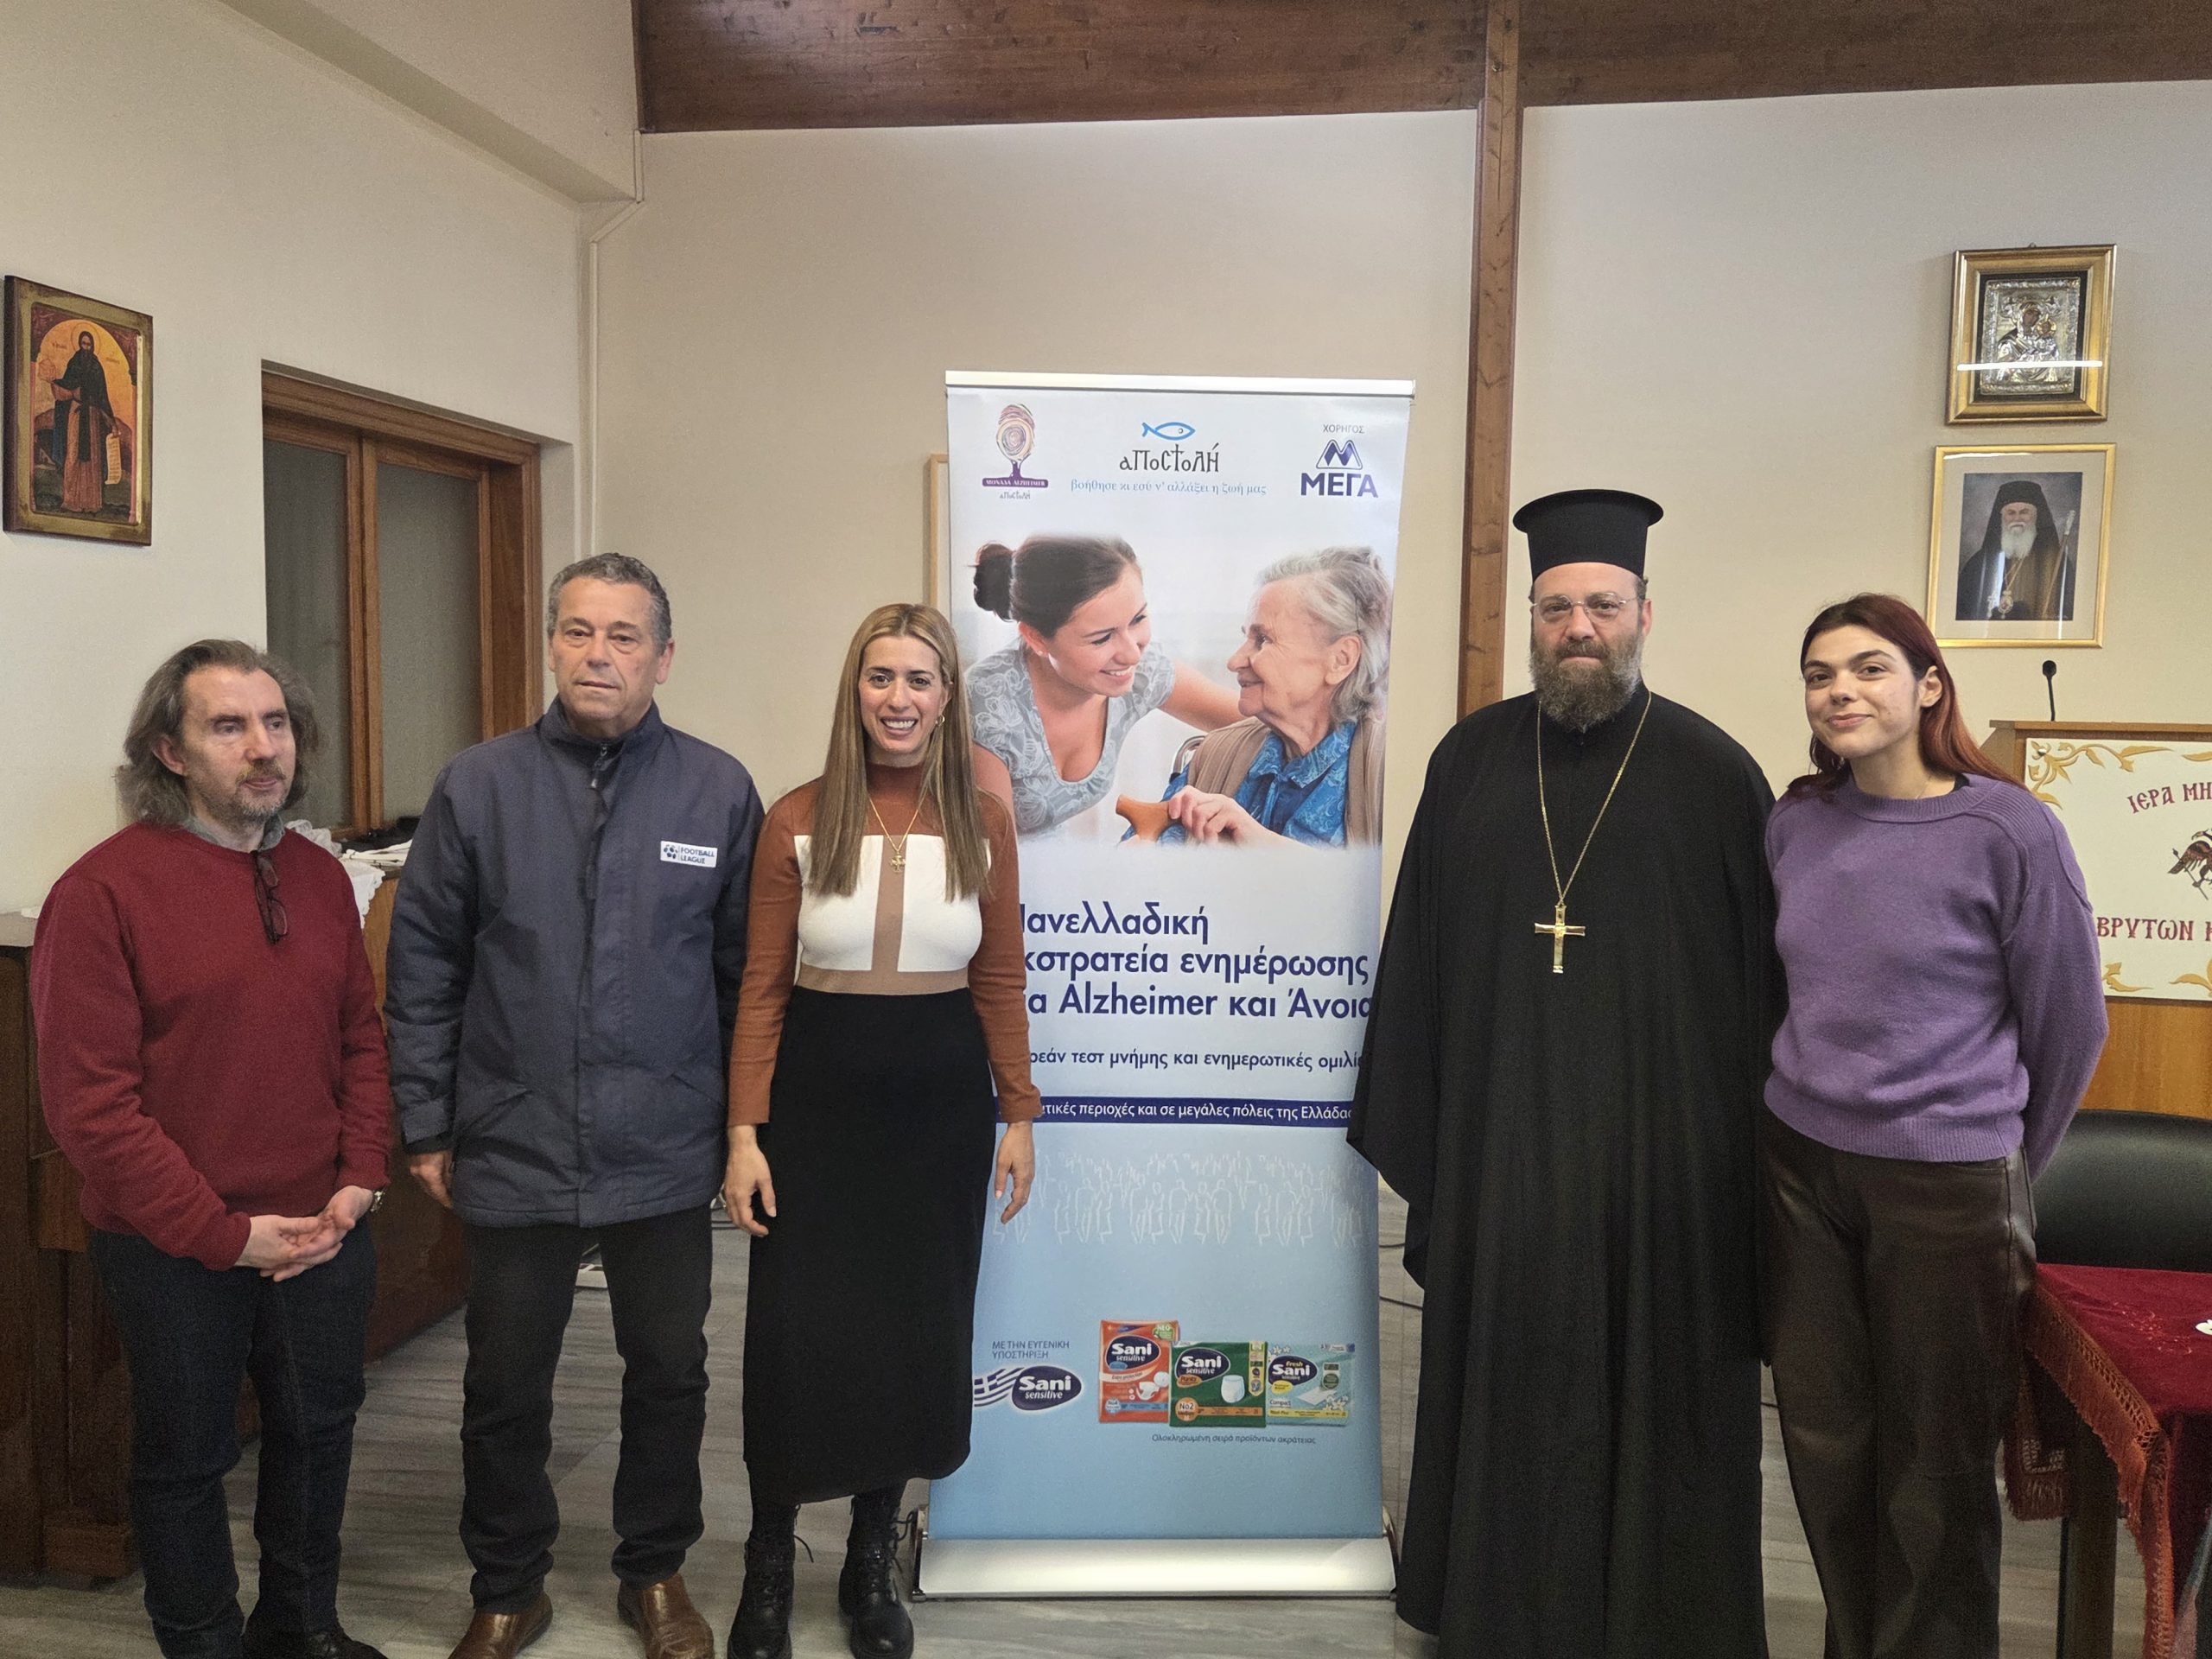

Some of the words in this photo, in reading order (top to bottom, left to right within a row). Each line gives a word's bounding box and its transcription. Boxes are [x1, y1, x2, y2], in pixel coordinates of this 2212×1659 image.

[1322, 424, 1365, 435] ΧΟΡΗΓΟΣ
[1071, 479, 1117, 493] βοήθησε
[1133, 480, 1152, 492] εσύ
[1167, 481, 1209, 496] αλλάξει
[1212, 485, 1219, 496] η
[1222, 481, 1243, 496] ζωή
[1246, 484, 1267, 496] μας
[1300, 472, 1379, 499] ΜΕΓΑ
[680, 847, 715, 857] FOOTBALL
[680, 855, 706, 864] LEAGUE
[1025, 944, 1168, 982] κστρατεία
[1180, 944, 1369, 986] ενημέρωσης
[1058, 981, 1218, 1015] Alzheimer
[1230, 996, 1275, 1017] και
[1030, 1047, 1066, 1064] ρεάν
[1071, 1052, 1105, 1064] τεστ
[1109, 1048, 1168, 1070] μνήμης
[1173, 1052, 1198, 1065] και
[1204, 1052, 1313, 1072] ενημερωτικές
[1319, 1050, 1362, 1073] ομιλί
[1042, 1102, 1077, 1116] τικές
[1079, 1103, 1135, 1118] περιοχές
[1137, 1105, 1158, 1116] και
[1160, 1106, 1176, 1116] σε
[1178, 1103, 1230, 1119] μεγάλες
[1232, 1103, 1274, 1119] πόλεις
[1276, 1108, 1298, 1121] της
[992, 1340, 1007, 1349] ΜΕ
[1007, 1340, 1026, 1349] ΤΗΝ
[1027, 1340, 1070, 1349] ΕΥΓΕΝΙΚΗ
[1111, 1343, 1153, 1355] Sani
[992, 1350, 1049, 1359] ΥΠΟΣΤΗΡΙΞΗ
[1180, 1355, 1222, 1368] Sani
[1271, 1364, 1311, 1376] Sani
[1018, 1375, 1071, 1391] Sani
[1025, 1390, 1063, 1400] sensitive
[1152, 1433, 1211, 1444] Ολοκληρωμένη
[1212, 1434, 1234, 1445] σειρά
[1236, 1434, 1275, 1445] προϊόντων
[1277, 1435, 1317, 1446] ακράτειας
